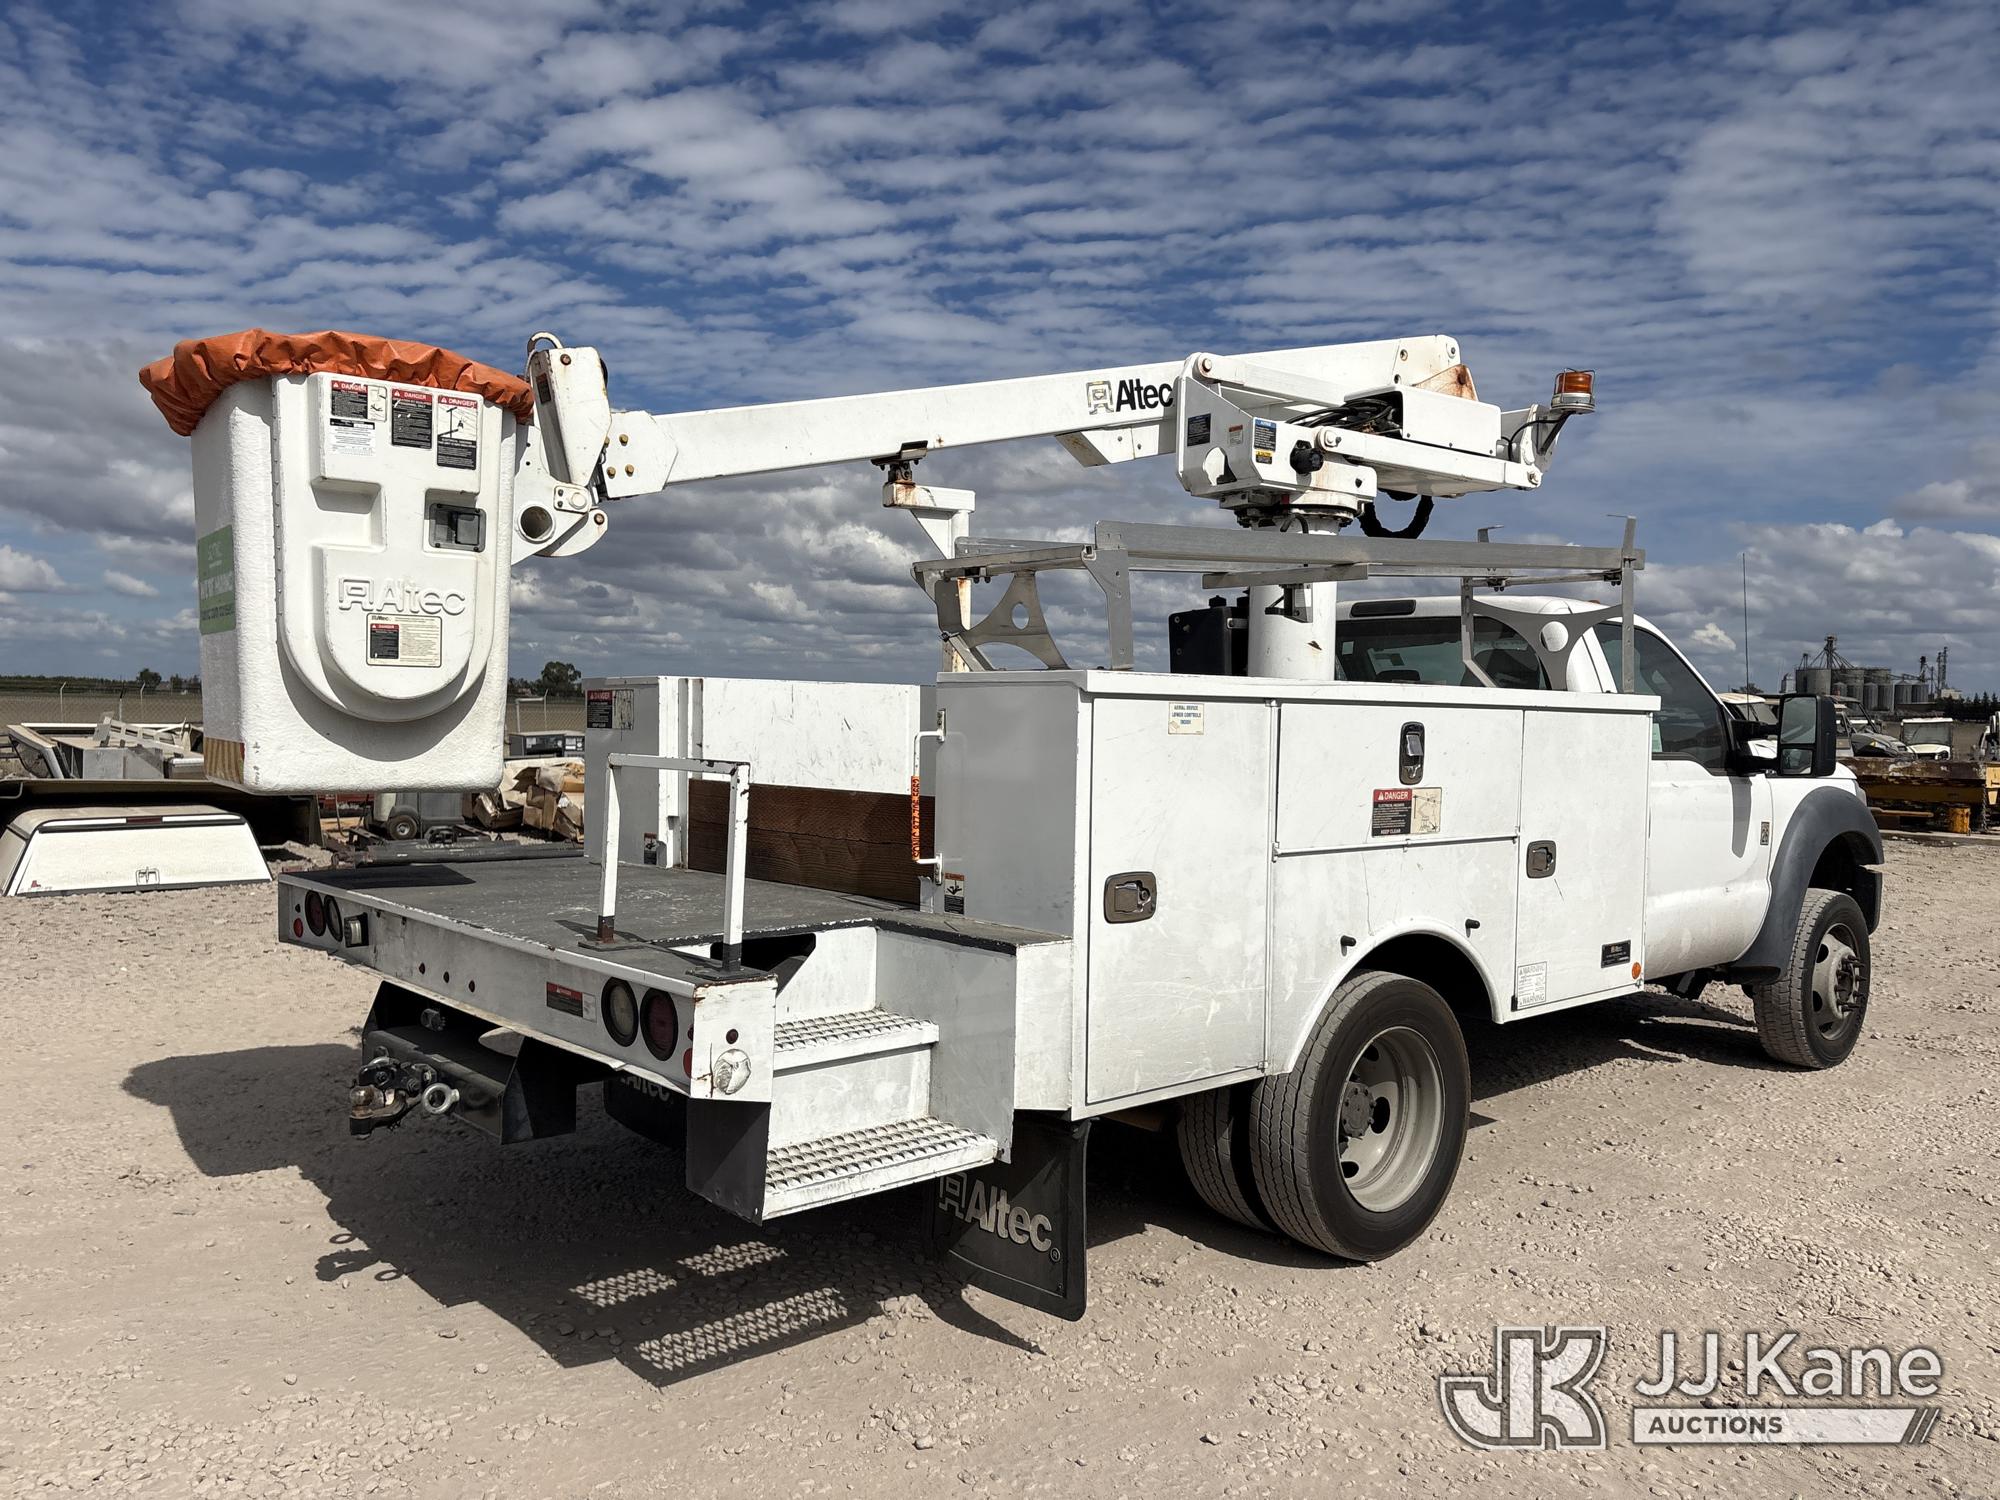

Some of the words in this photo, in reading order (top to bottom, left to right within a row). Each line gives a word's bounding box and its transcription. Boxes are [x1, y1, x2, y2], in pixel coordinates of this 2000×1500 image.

[1116, 378, 1174, 412] Altec
[376, 578, 466, 616] Altec
[1384, 791, 1409, 801] DANGER
[965, 1180, 1052, 1251] Altec
